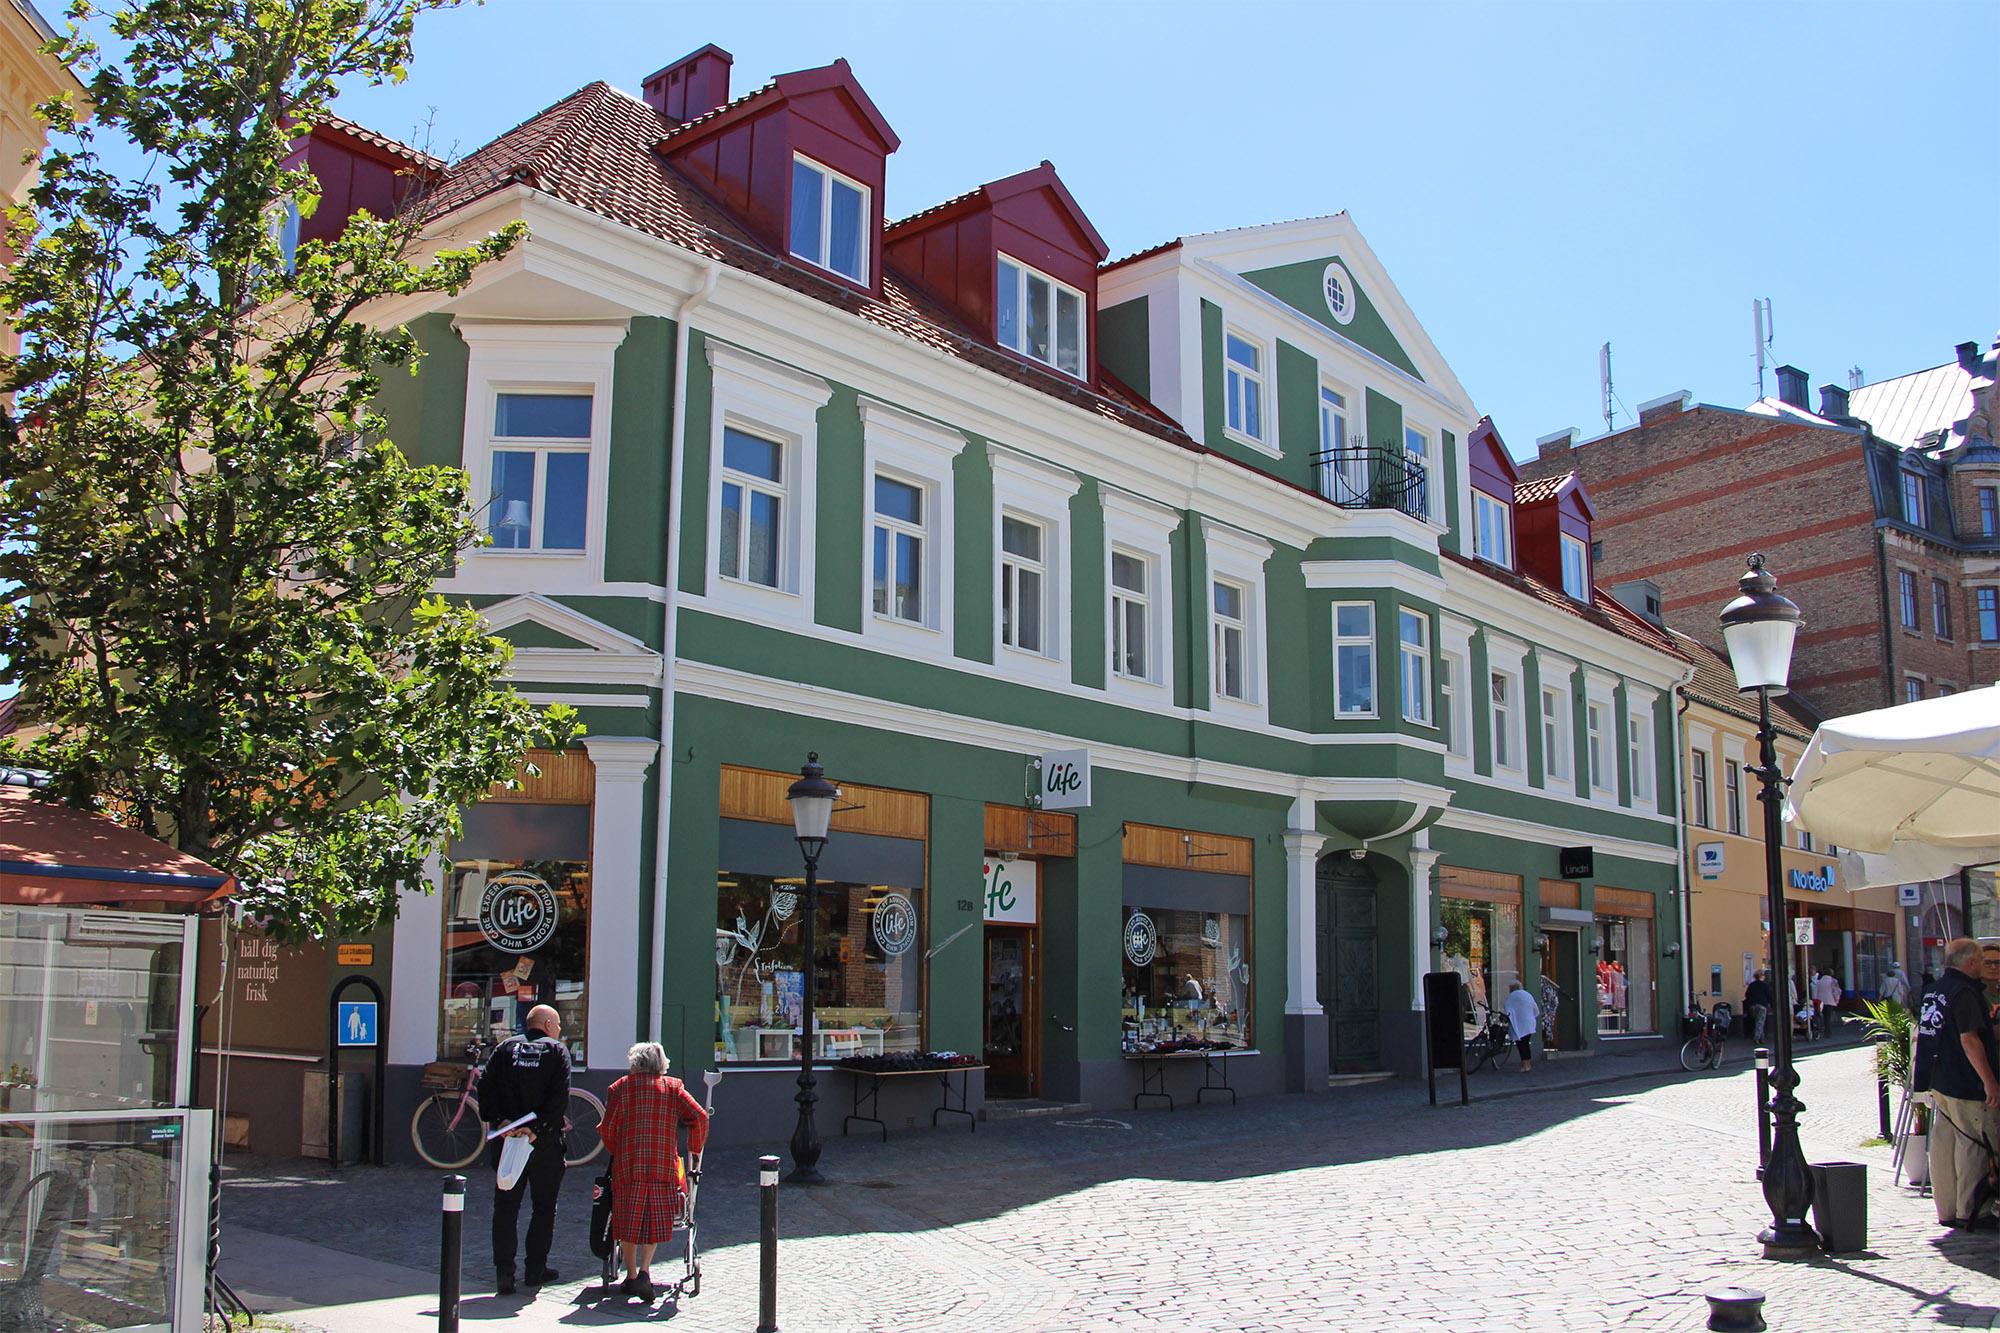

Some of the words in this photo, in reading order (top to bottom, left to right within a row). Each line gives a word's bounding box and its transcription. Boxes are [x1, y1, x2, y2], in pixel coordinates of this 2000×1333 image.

[1047, 763, 1082, 796] life
[1566, 864, 1589, 874] Lindri
[507, 877, 538, 889] ADVICE
[1790, 869, 1828, 892] Nordea
[482, 881, 504, 912] EXPERT
[539, 888, 553, 914] FROM
[956, 899, 974, 911] 12B
[500, 896, 538, 926] life
[482, 917, 499, 939] CARE
[525, 917, 552, 946] PEOPLE
[885, 912, 906, 935] life
[240, 939, 259, 958] håll
[261, 940, 280, 961] dig
[501, 939, 523, 948] WHO
[237, 961, 279, 983] naturligt
[761, 960, 793, 972] Trifolium
[245, 982, 268, 1001] frisk
